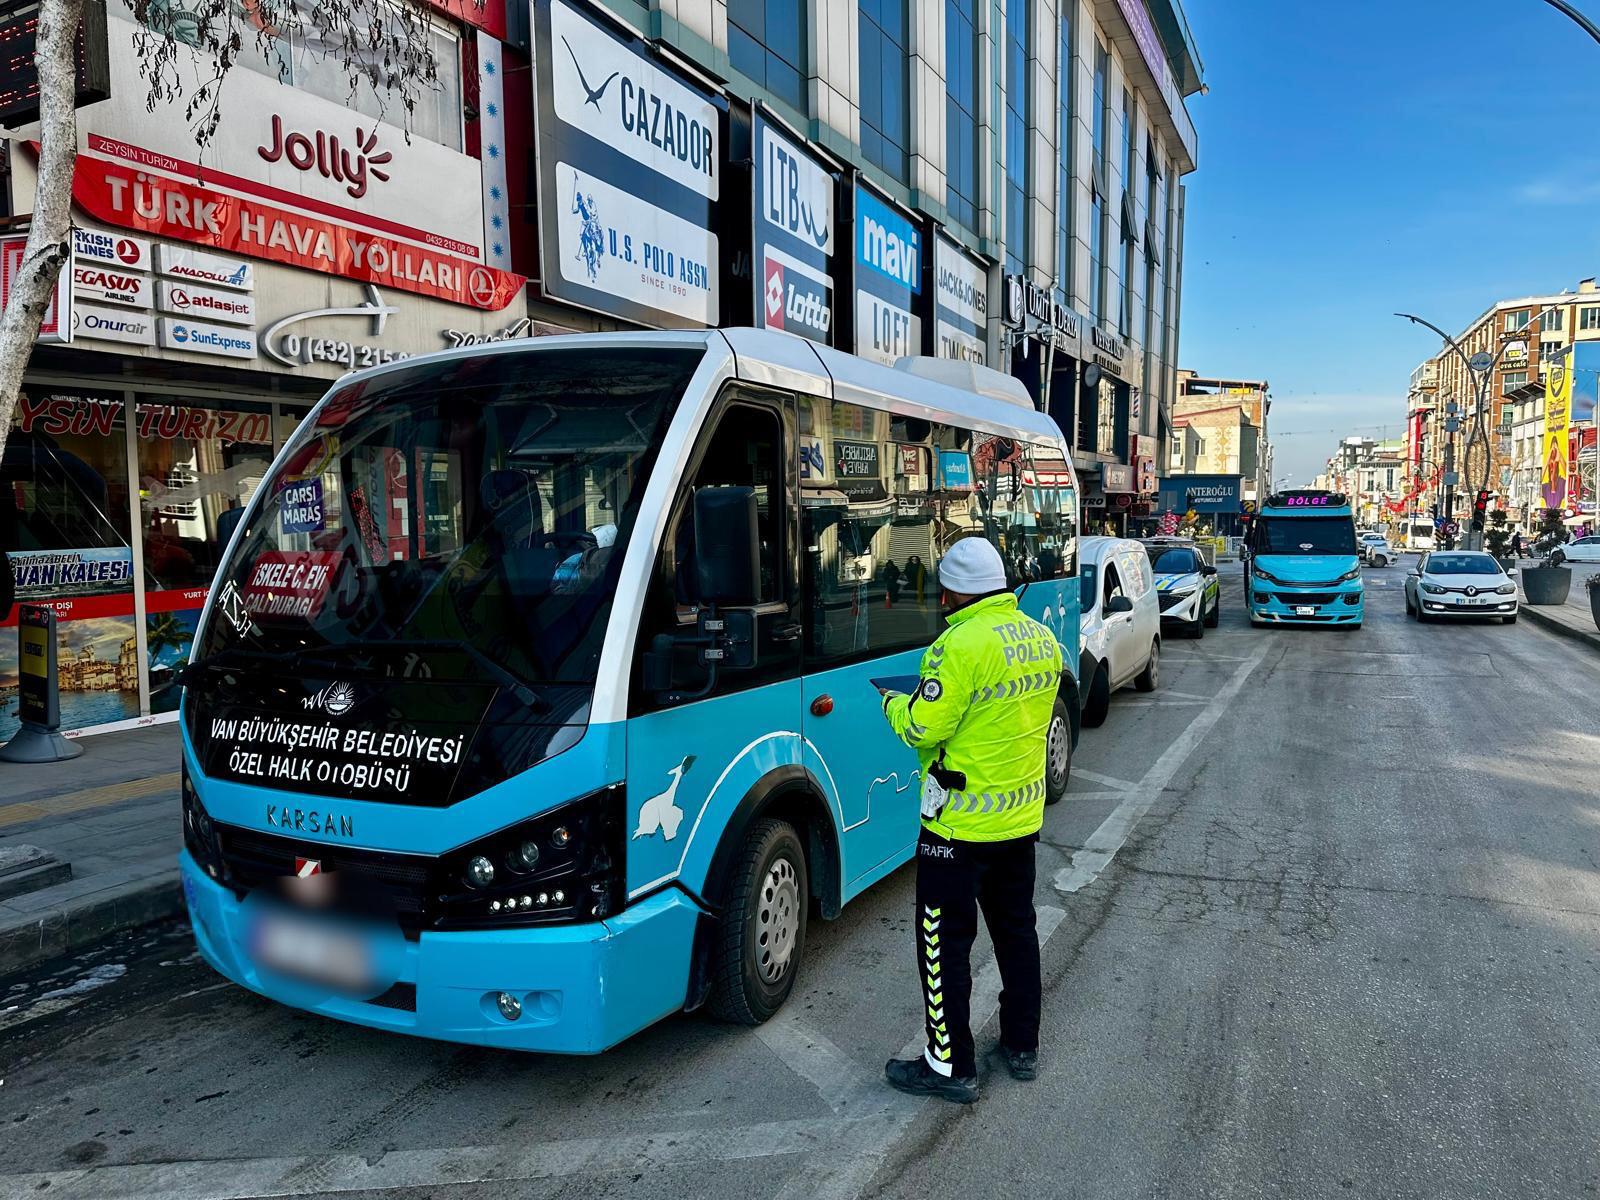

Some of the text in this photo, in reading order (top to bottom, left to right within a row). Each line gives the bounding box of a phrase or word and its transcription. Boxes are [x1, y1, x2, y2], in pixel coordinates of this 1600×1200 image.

[621, 76, 713, 177] CAZADOR
[257, 114, 367, 199] Jolly
[769, 141, 799, 232] LTB
[104, 172, 462, 292] TÜRK HAVA YOLLARI
[425, 233, 443, 246] 0432
[864, 215, 917, 288] mavi
[608, 228, 711, 292] U.S. POLO ASSN.
[104, 291, 135, 303] AIRLINES
[192, 295, 249, 315] atlasjet
[641, 274, 687, 297] SINCE 1890
[938, 265, 986, 314] JACK&JONES
[191, 330, 251, 350] SunExpress
[874, 302, 908, 356] LOFT
[306, 336, 354, 369] (432)
[15, 564, 56, 588] VAN
[211, 716, 464, 764] VAN BÜYÜKŞEHİR BELEDİYESİ
[229, 745, 264, 777] ÖZEL
[269, 752, 313, 782] HALK
[266, 803, 354, 837] KARSAN
